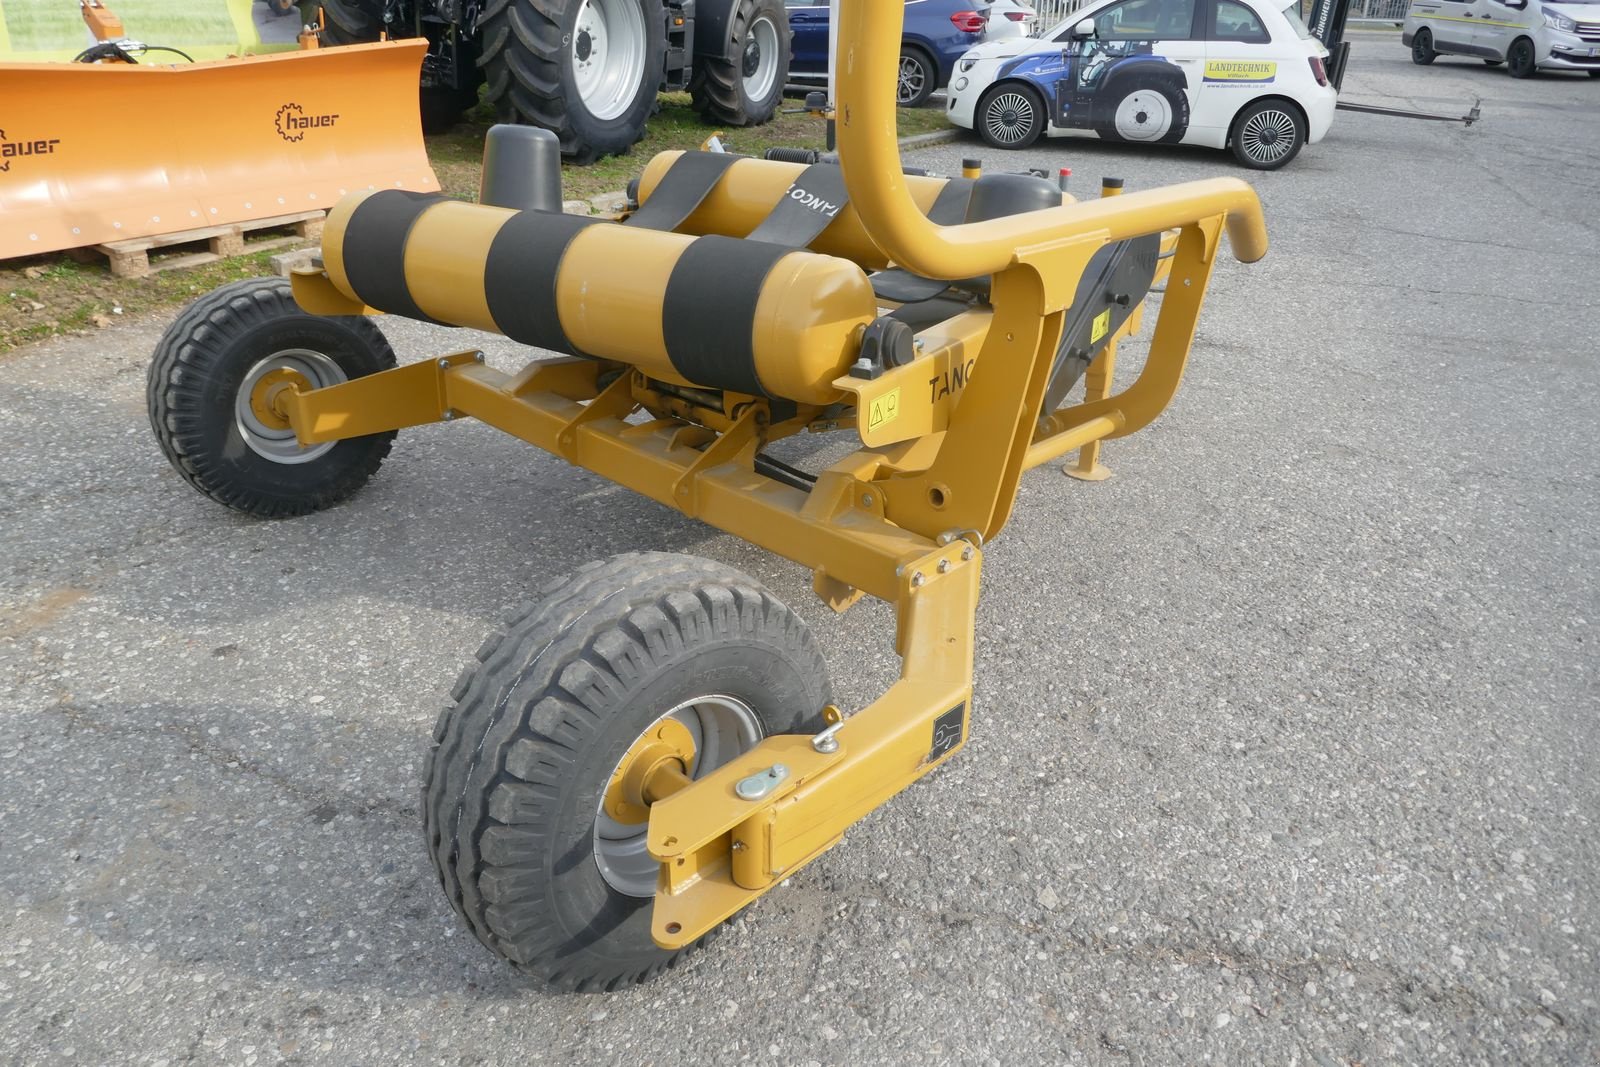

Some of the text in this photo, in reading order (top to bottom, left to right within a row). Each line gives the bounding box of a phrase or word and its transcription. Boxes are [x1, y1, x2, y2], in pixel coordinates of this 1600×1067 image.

[1316, 0, 1331, 39] JUNGHEI
[1208, 62, 1270, 73] LANDTECHNIK
[287, 112, 340, 130] hauer
[1, 139, 60, 157] auer
[929, 358, 974, 404] TANC
